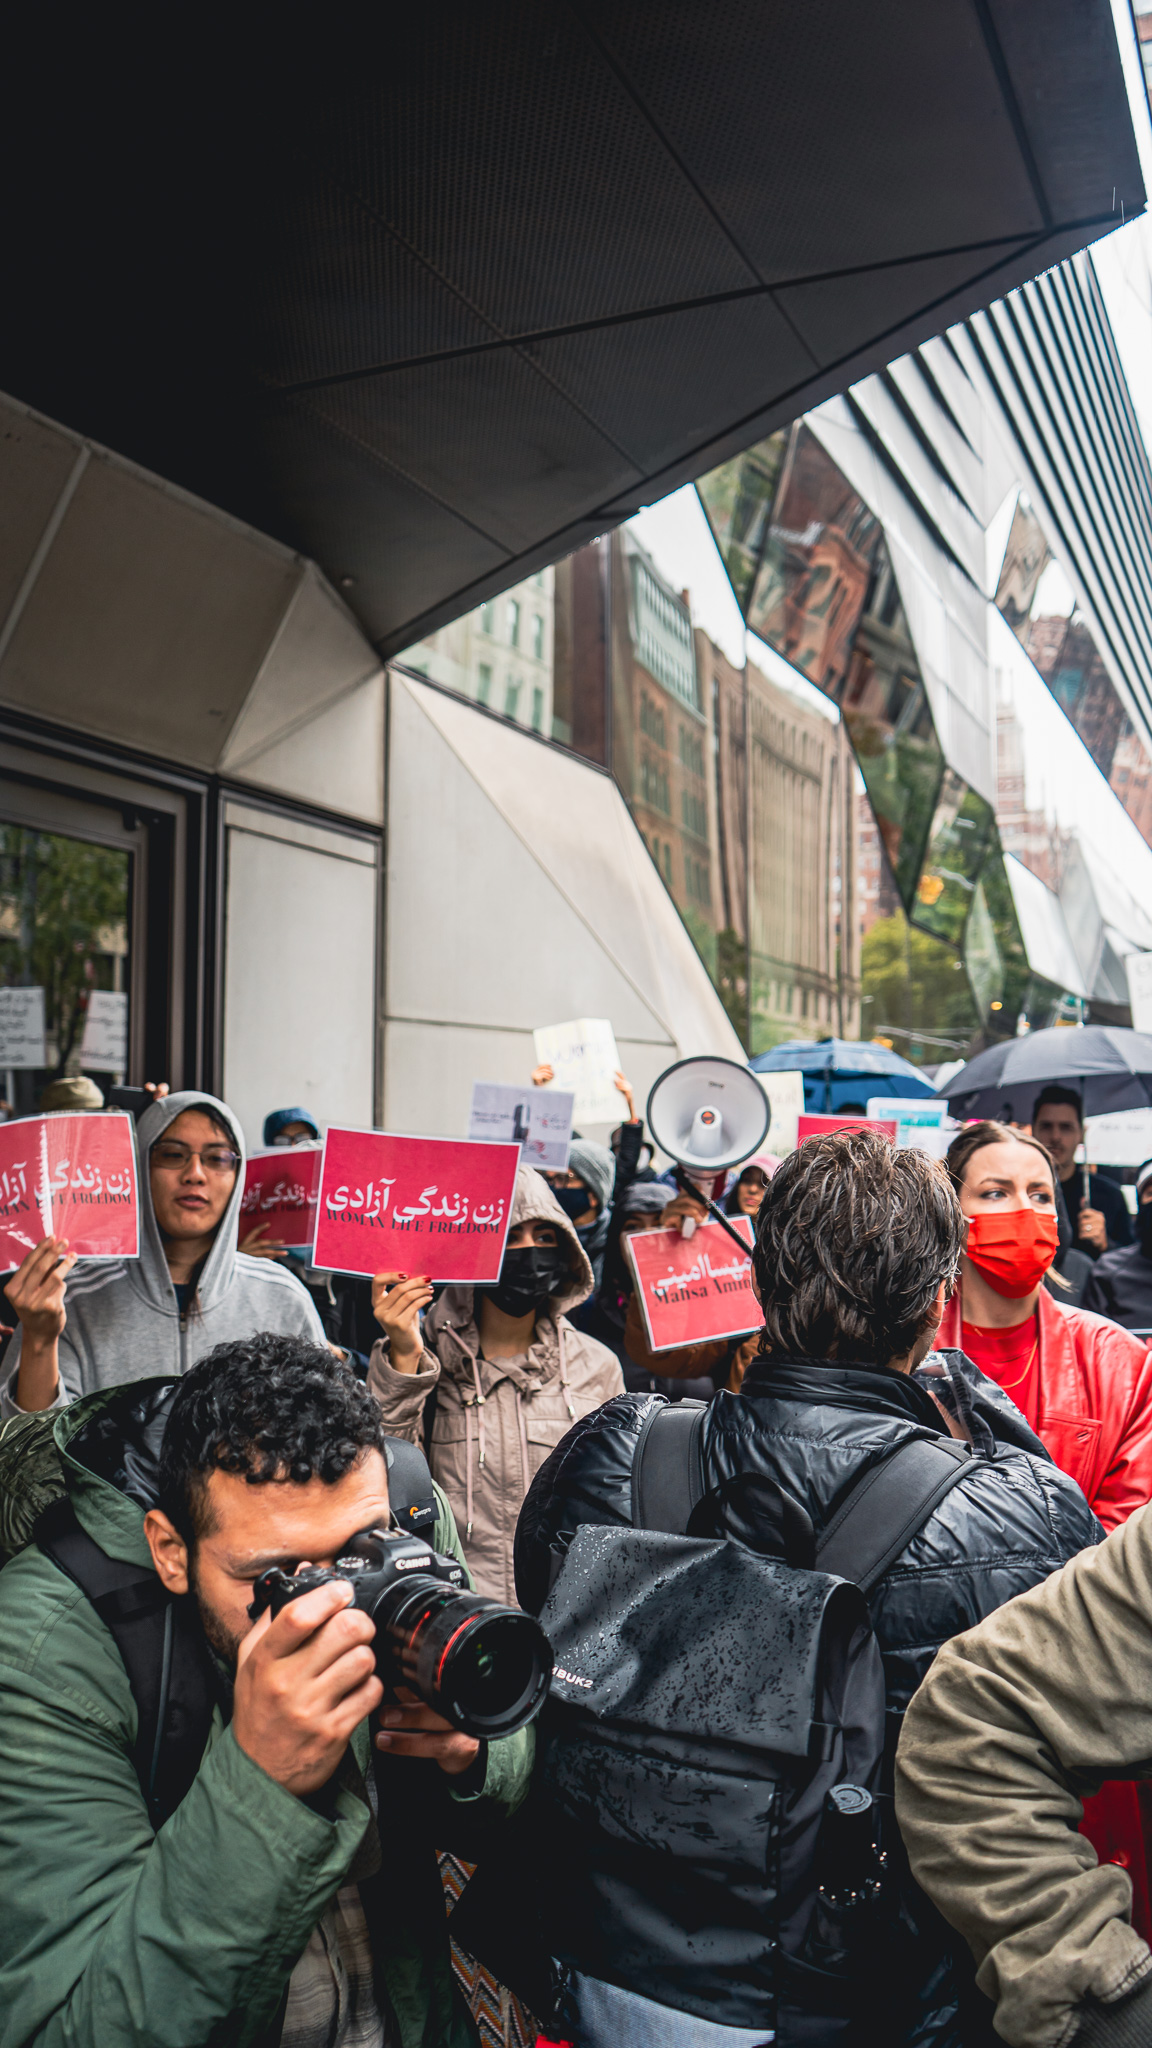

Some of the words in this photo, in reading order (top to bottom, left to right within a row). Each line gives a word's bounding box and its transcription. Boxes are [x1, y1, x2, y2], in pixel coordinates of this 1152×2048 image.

[0, 1160, 28, 1207] آزا
[106, 1168, 131, 1197] زن
[72, 1192, 131, 1205] FREEDOM
[325, 1177, 397, 1219] آزادی
[392, 1185, 470, 1225] زندگی
[472, 1198, 505, 1226] زن
[326, 1208, 385, 1229] WOMAN
[391, 1218, 424, 1232] LIFE
[428, 1220, 499, 1235] FREEDOM
[653, 1286, 709, 1307] Mahsa
[712, 1278, 752, 1295] Amin
[394, 1556, 432, 1570] Canon
